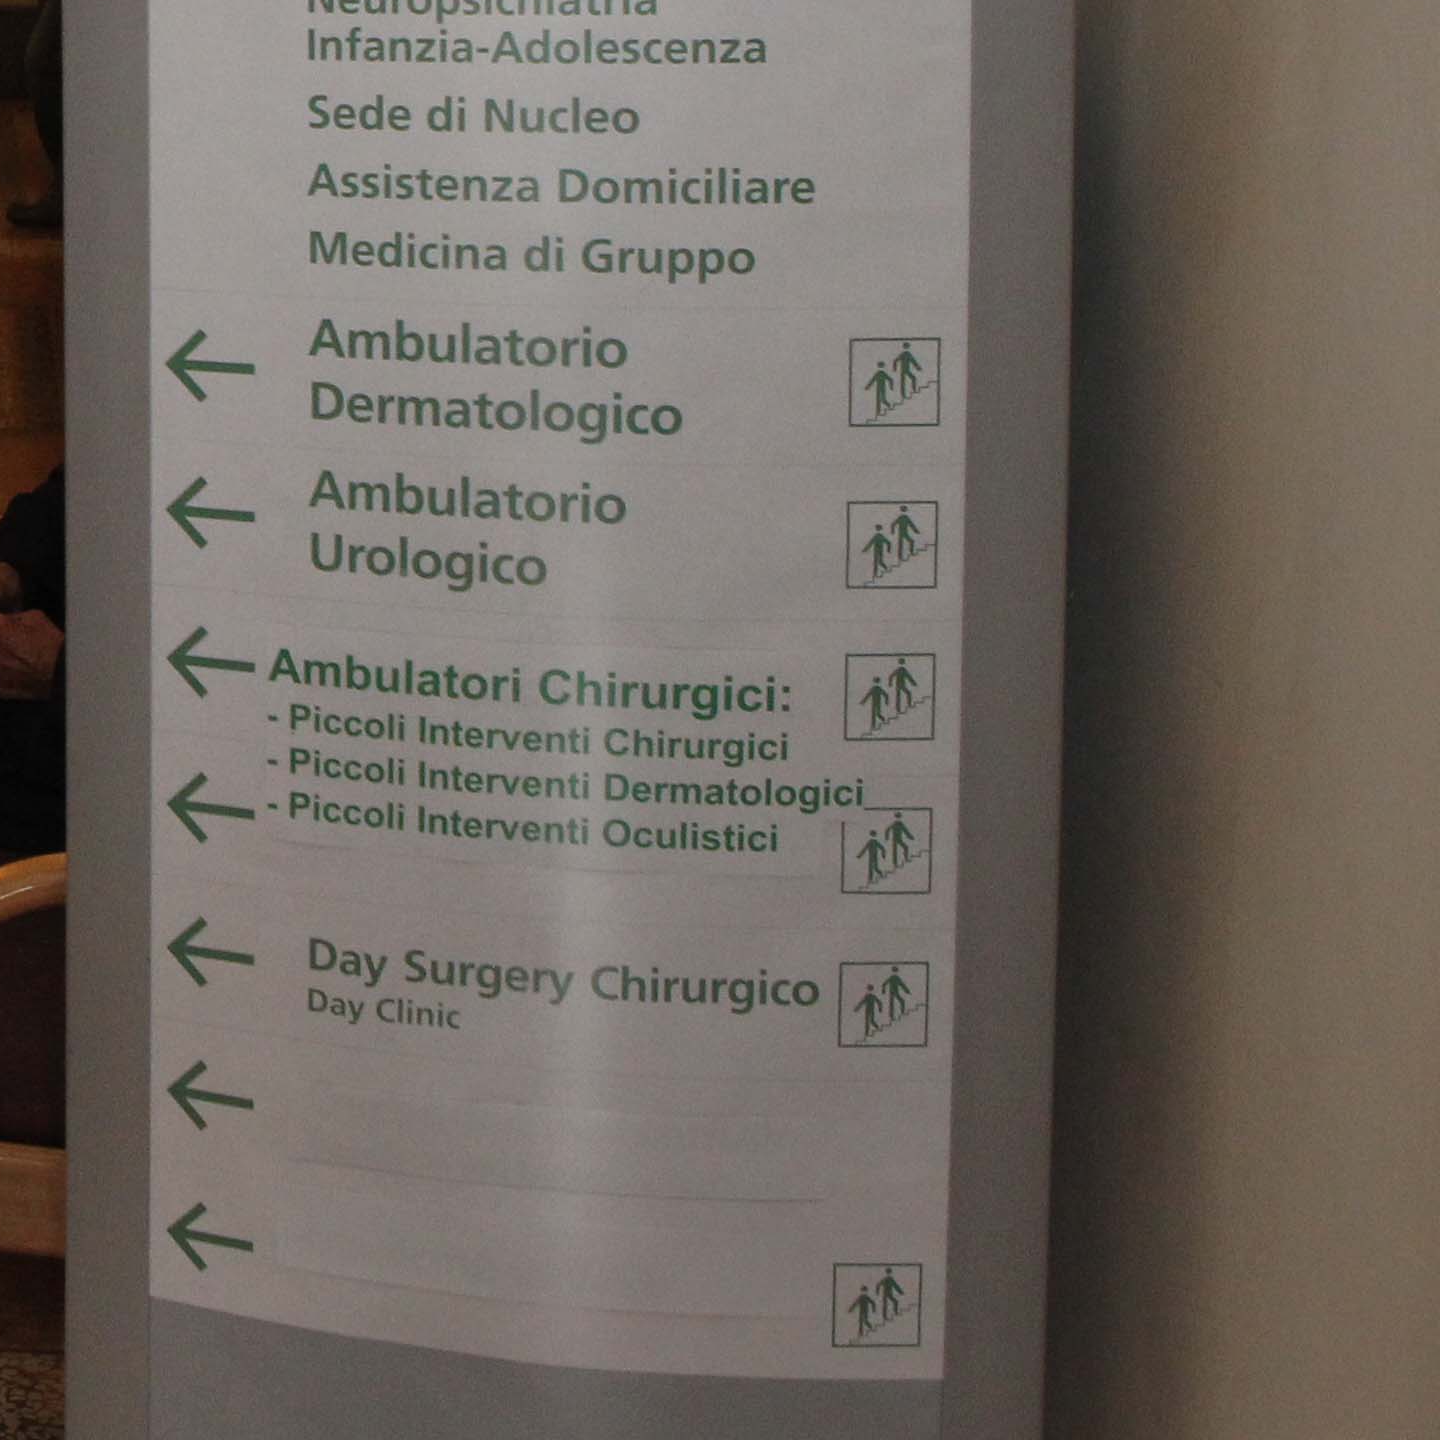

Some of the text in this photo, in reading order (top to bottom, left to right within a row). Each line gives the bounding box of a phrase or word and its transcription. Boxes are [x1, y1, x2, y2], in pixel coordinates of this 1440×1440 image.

[306, 29, 767, 66] Infanzia-Adolescenza
[308, 95, 640, 135] Sede di Nucleo
[308, 164, 815, 207] Assistenza Domiciliare
[309, 232, 755, 282] Medicina di Gruppo
[309, 319, 627, 369] Ambulatorio
[311, 383, 683, 444] Dermatologico
[309, 470, 627, 526] Ambulatorio
[310, 532, 547, 591] Urologico
[268, 648, 791, 716] Ambulatori Chirurgici:
[289, 704, 405, 743] Piccoli
[418, 715, 590, 756] Interventi
[604, 728, 788, 767] Chirurgici
[288, 748, 405, 788] Piccoli
[417, 760, 590, 801] Interventi
[604, 773, 863, 813] Dermatologici
[288, 793, 405, 833] Piccoli
[417, 805, 590, 846] Interventi
[602, 819, 778, 854] Oculistici
[309, 937, 820, 1014] Day Surgery Chirurgico
[307, 988, 460, 1030] Day Clinic
